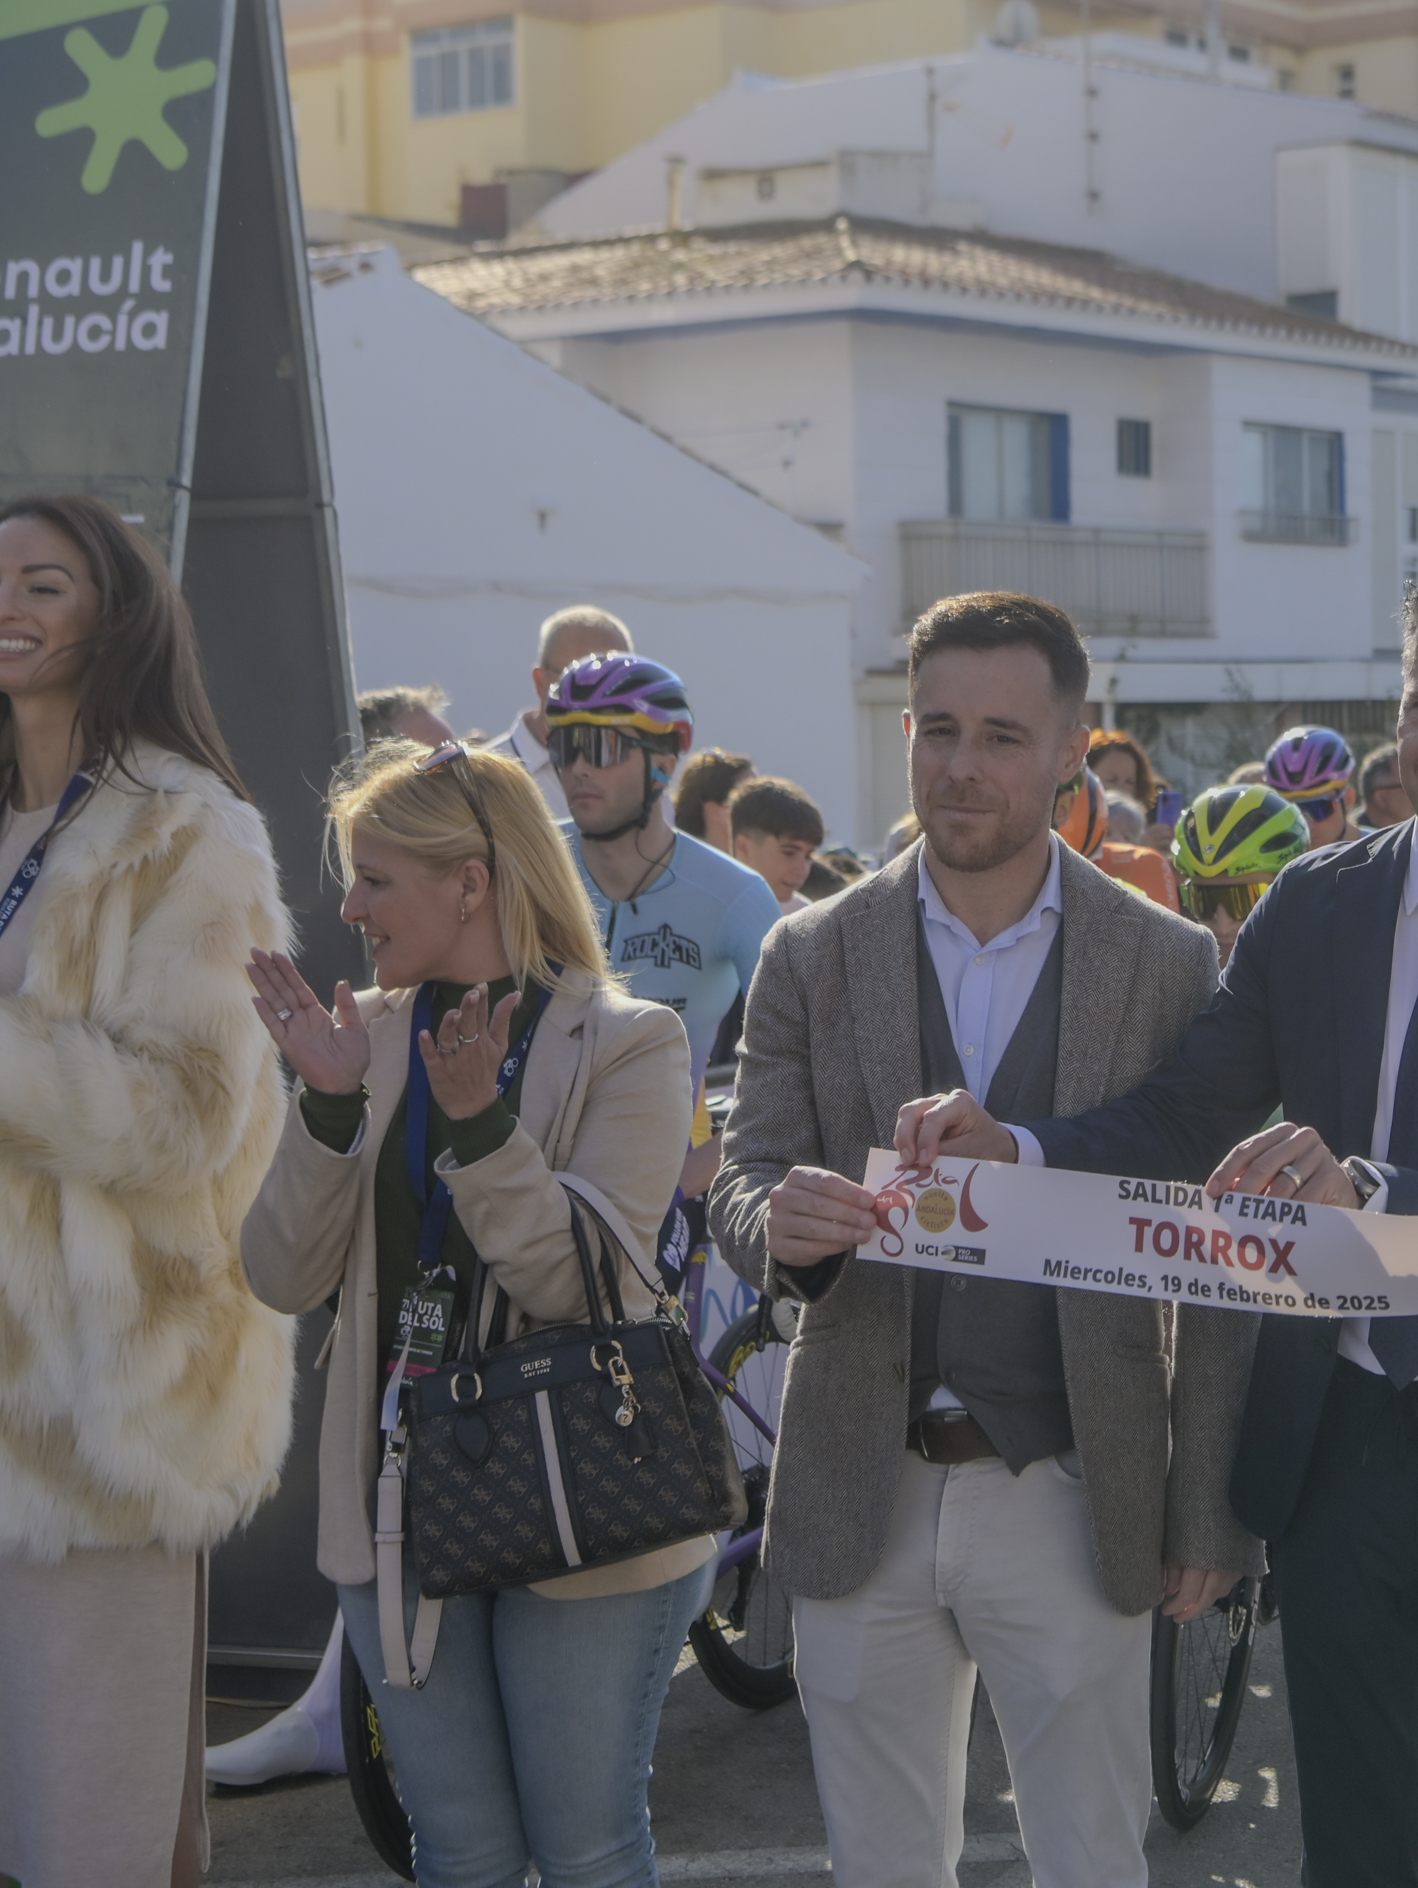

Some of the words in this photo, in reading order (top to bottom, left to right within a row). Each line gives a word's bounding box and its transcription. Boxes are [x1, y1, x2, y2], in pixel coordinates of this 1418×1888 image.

[1, 239, 174, 300] nault
[620, 922, 702, 970] ROCKETS
[923, 1191, 949, 1202] vuelta
[1118, 1179, 1203, 1210] SALIDA
[1238, 1196, 1308, 1227] ETAPA
[920, 1215, 949, 1229] ciclista
[915, 1243, 939, 1257] UCI
[1128, 1216, 1298, 1277] TORROX
[957, 1254, 978, 1262] SERIES
[1042, 1258, 1153, 1292] Miercoles,
[1160, 1274, 1182, 1293] 19
[1187, 1278, 1211, 1298] de
[1217, 1281, 1297, 1308] febrero
[1303, 1292, 1331, 1310] de
[1336, 1294, 1391, 1311] 2025
[421, 1315, 445, 1331] SOL
[520, 1357, 552, 1373] GUESS
